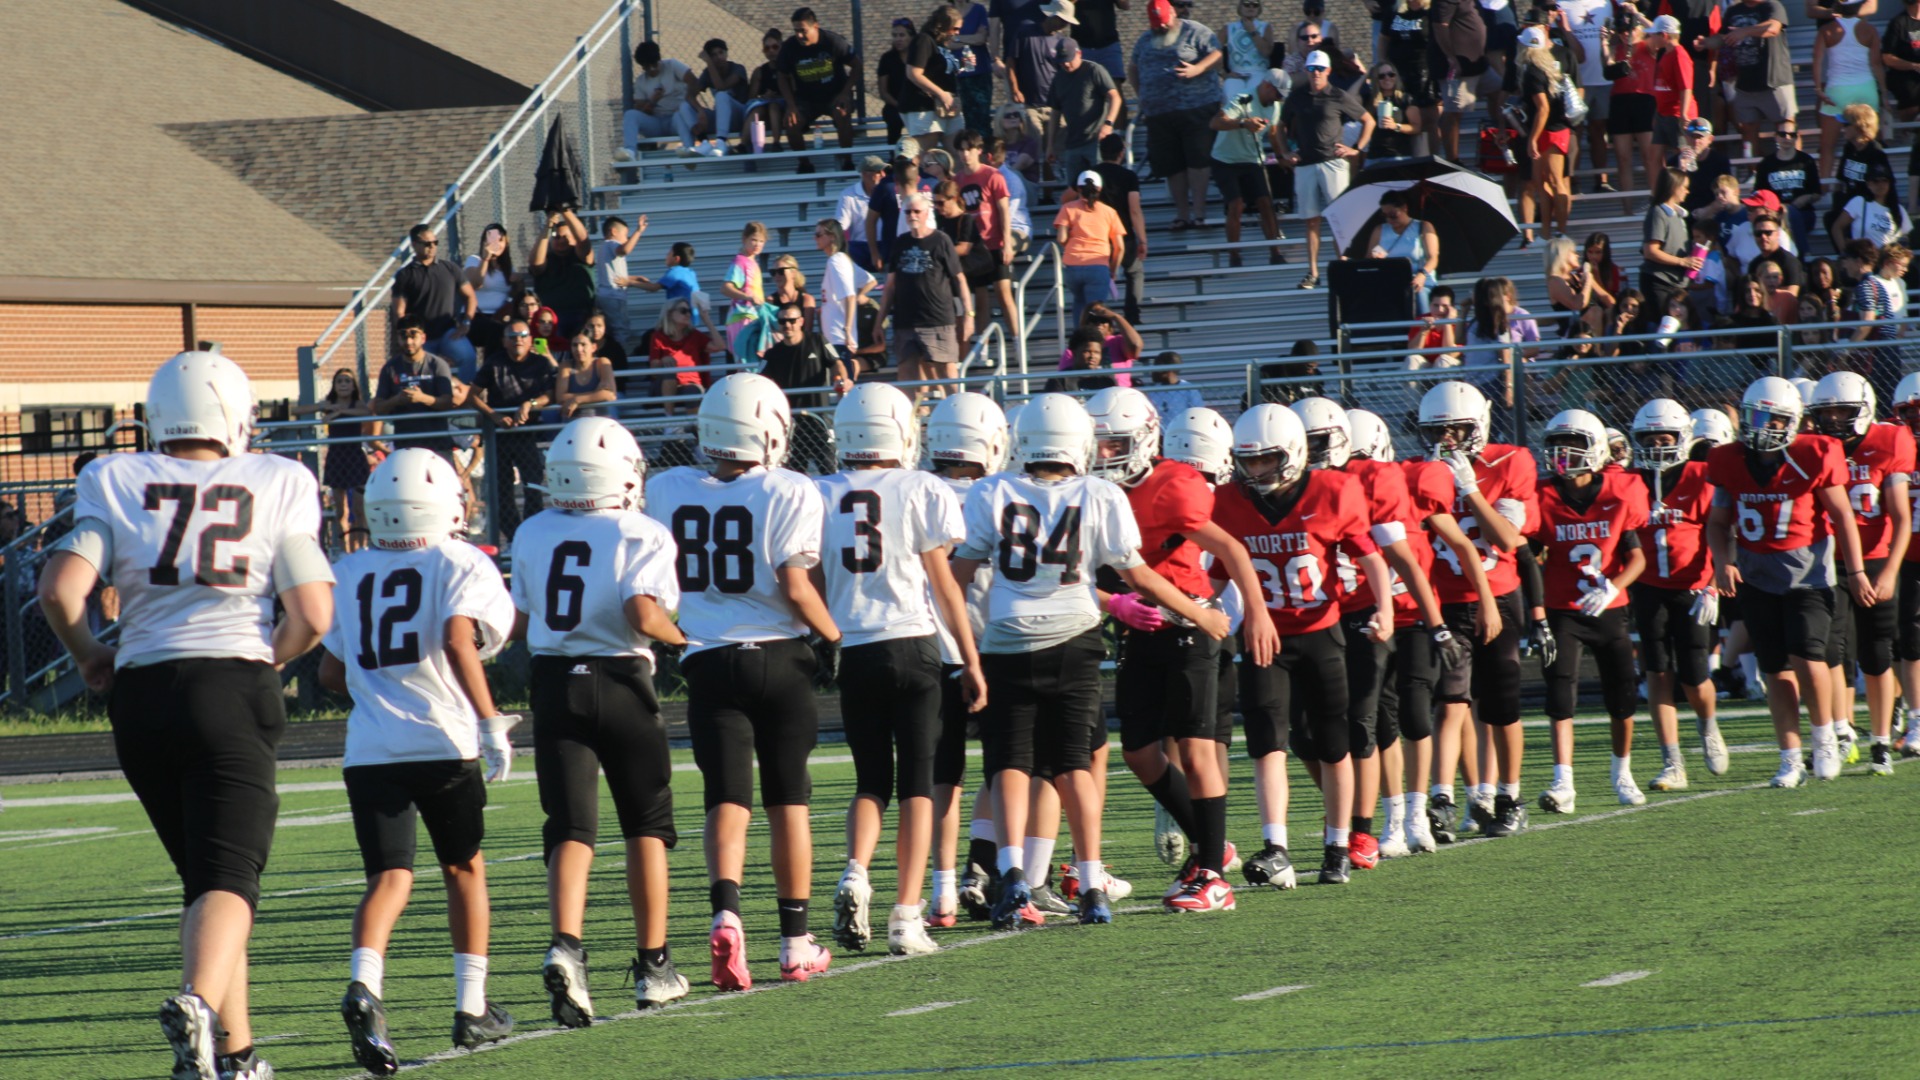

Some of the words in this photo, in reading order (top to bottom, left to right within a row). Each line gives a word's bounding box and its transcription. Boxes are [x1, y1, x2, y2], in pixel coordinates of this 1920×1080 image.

[703, 446, 736, 458] Riddell
[143, 483, 254, 588] 72
[378, 537, 427, 549] Riddell
[672, 504, 755, 594] 88
[840, 489, 883, 574] 3
[998, 501, 1083, 586] 84
[1244, 532, 1310, 554] NORTH
[1555, 520, 1611, 541] NORTH
[1654, 528, 1669, 578] 1
[545, 540, 592, 632] 6
[1250, 553, 1328, 609] 30
[1569, 543, 1606, 597] 3
[356, 567, 423, 670] 12
